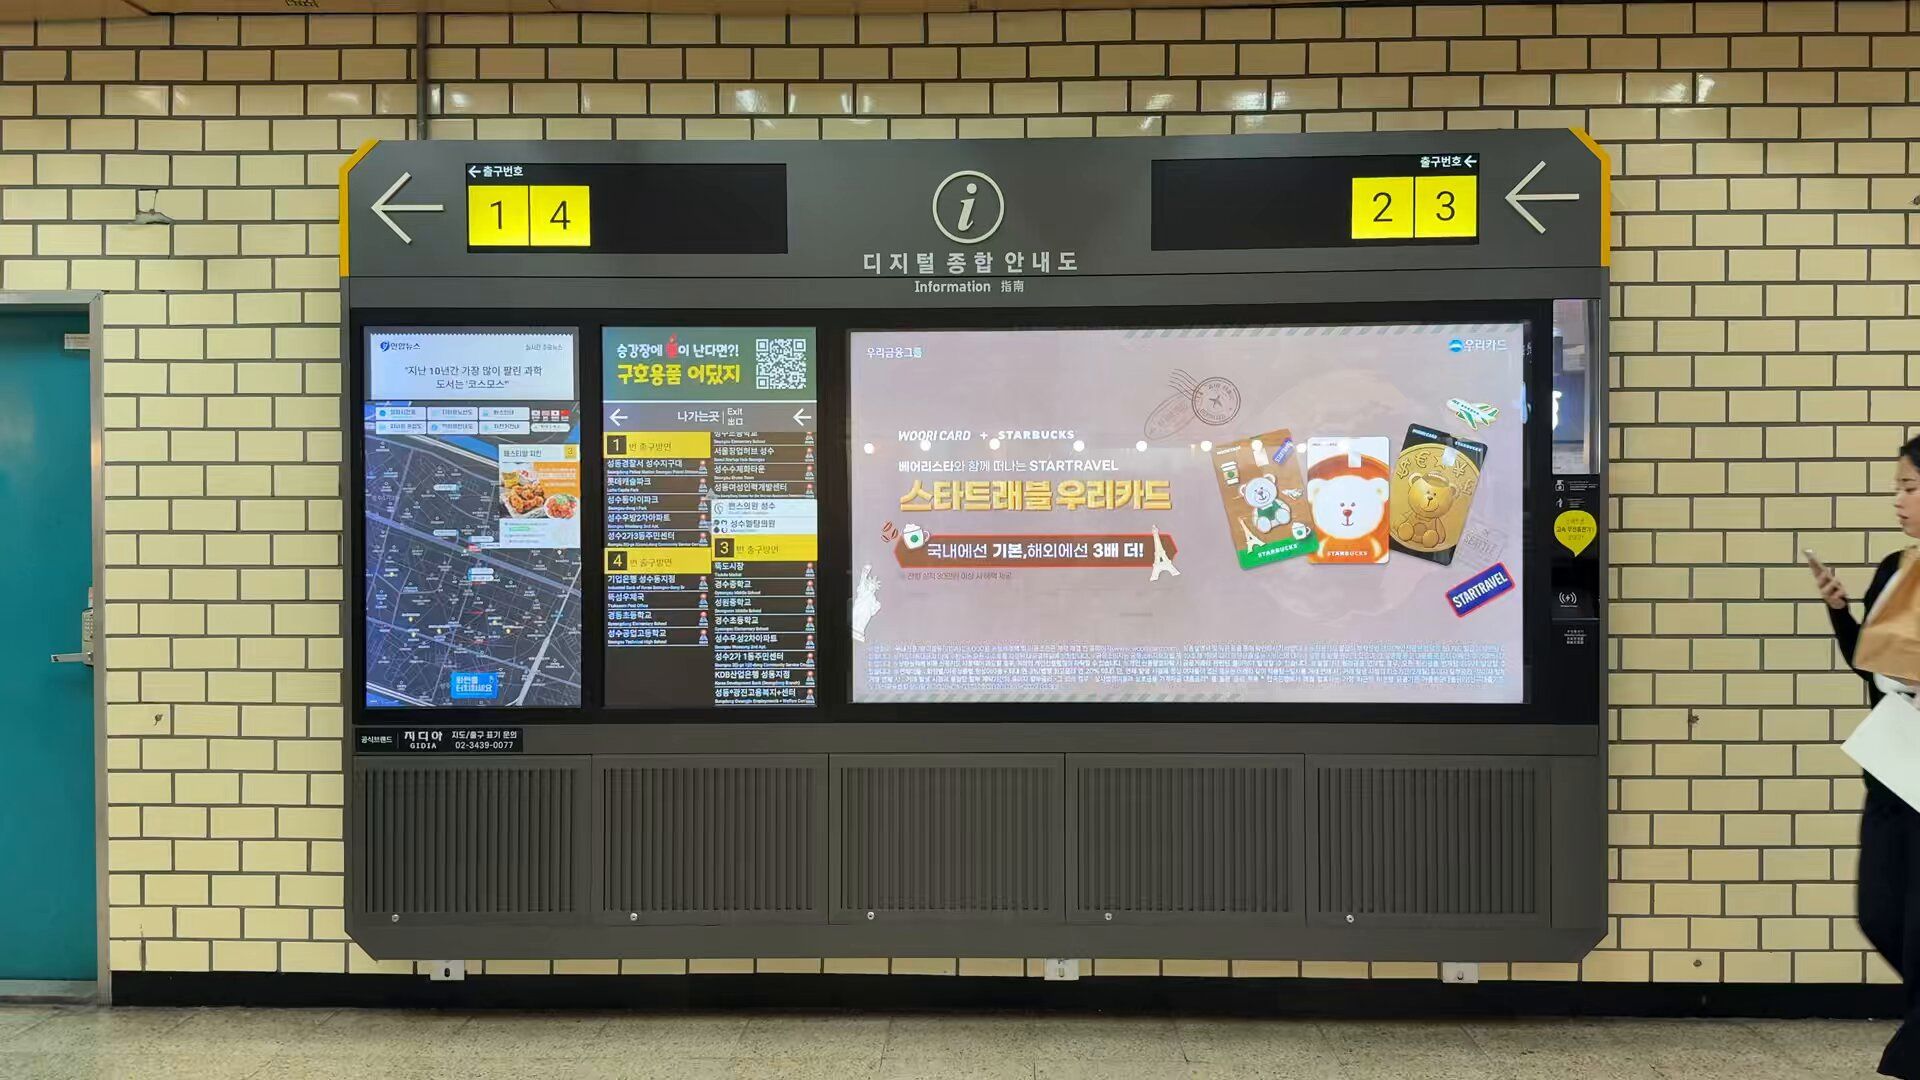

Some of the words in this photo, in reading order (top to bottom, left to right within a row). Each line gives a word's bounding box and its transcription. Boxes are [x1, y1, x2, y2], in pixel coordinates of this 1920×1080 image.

[1420, 156, 1462, 168] 출구번호
[483, 166, 523, 177] 출구번호
[1373, 192, 1393, 222] 2
[1436, 191, 1455, 221] 3
[490, 201, 502, 230] 1
[550, 201, 571, 230] 4
[863, 252, 934, 275] 디지털
[947, 252, 993, 275] 종합
[1004, 251, 1078, 273] 안내도
[915, 280, 991, 293] Information
[1001, 280, 1024, 292] 指南
[617, 344, 663, 358] 승강장에
[693, 344, 740, 358] 난다면?!
[1463, 339, 1508, 352] 우리카드
[867, 347, 922, 359] 우리금융그룹
[461, 366, 479, 376] 가장
[483, 366, 500, 376] 많이
[524, 366, 542, 376] 과학
[617, 363, 681, 386] 구호용품
[687, 364, 740, 384] 어딨지
[436, 380, 464, 389] 도서는
[677, 411, 720, 423] 나가는곳
[727, 407, 743, 416] Exit
[727, 417, 743, 426] 出口
[898, 430, 938, 441] WOORI
[939, 430, 971, 441] CARD
[998, 430, 1075, 440] STARBUCKS
[613, 439, 619, 451] 1
[898, 460, 965, 472] 베어리스타와
[968, 460, 989, 472] 함께
[993, 460, 1027, 472] 떠나는
[1030, 460, 1119, 472] STARTRAVEL
[720, 541, 729, 554] 3
[927, 543, 987, 559] 국내에선
[1093, 543, 1118, 558] 3배
[1123, 542, 1144, 558] 더!
[1258, 543, 1298, 558] STARBUCKS
[613, 554, 622, 567] 4
[1452, 572, 1508, 608] STARTRAVEL
[715, 671, 759, 679] KDB산업은행
[361, 736, 393, 744] 공식브랜드
[452, 731, 485, 739] 지도/출구
[486, 731, 501, 739] 표기
[503, 731, 517, 739] 문의
[455, 741, 514, 749] 02-3439-0077
